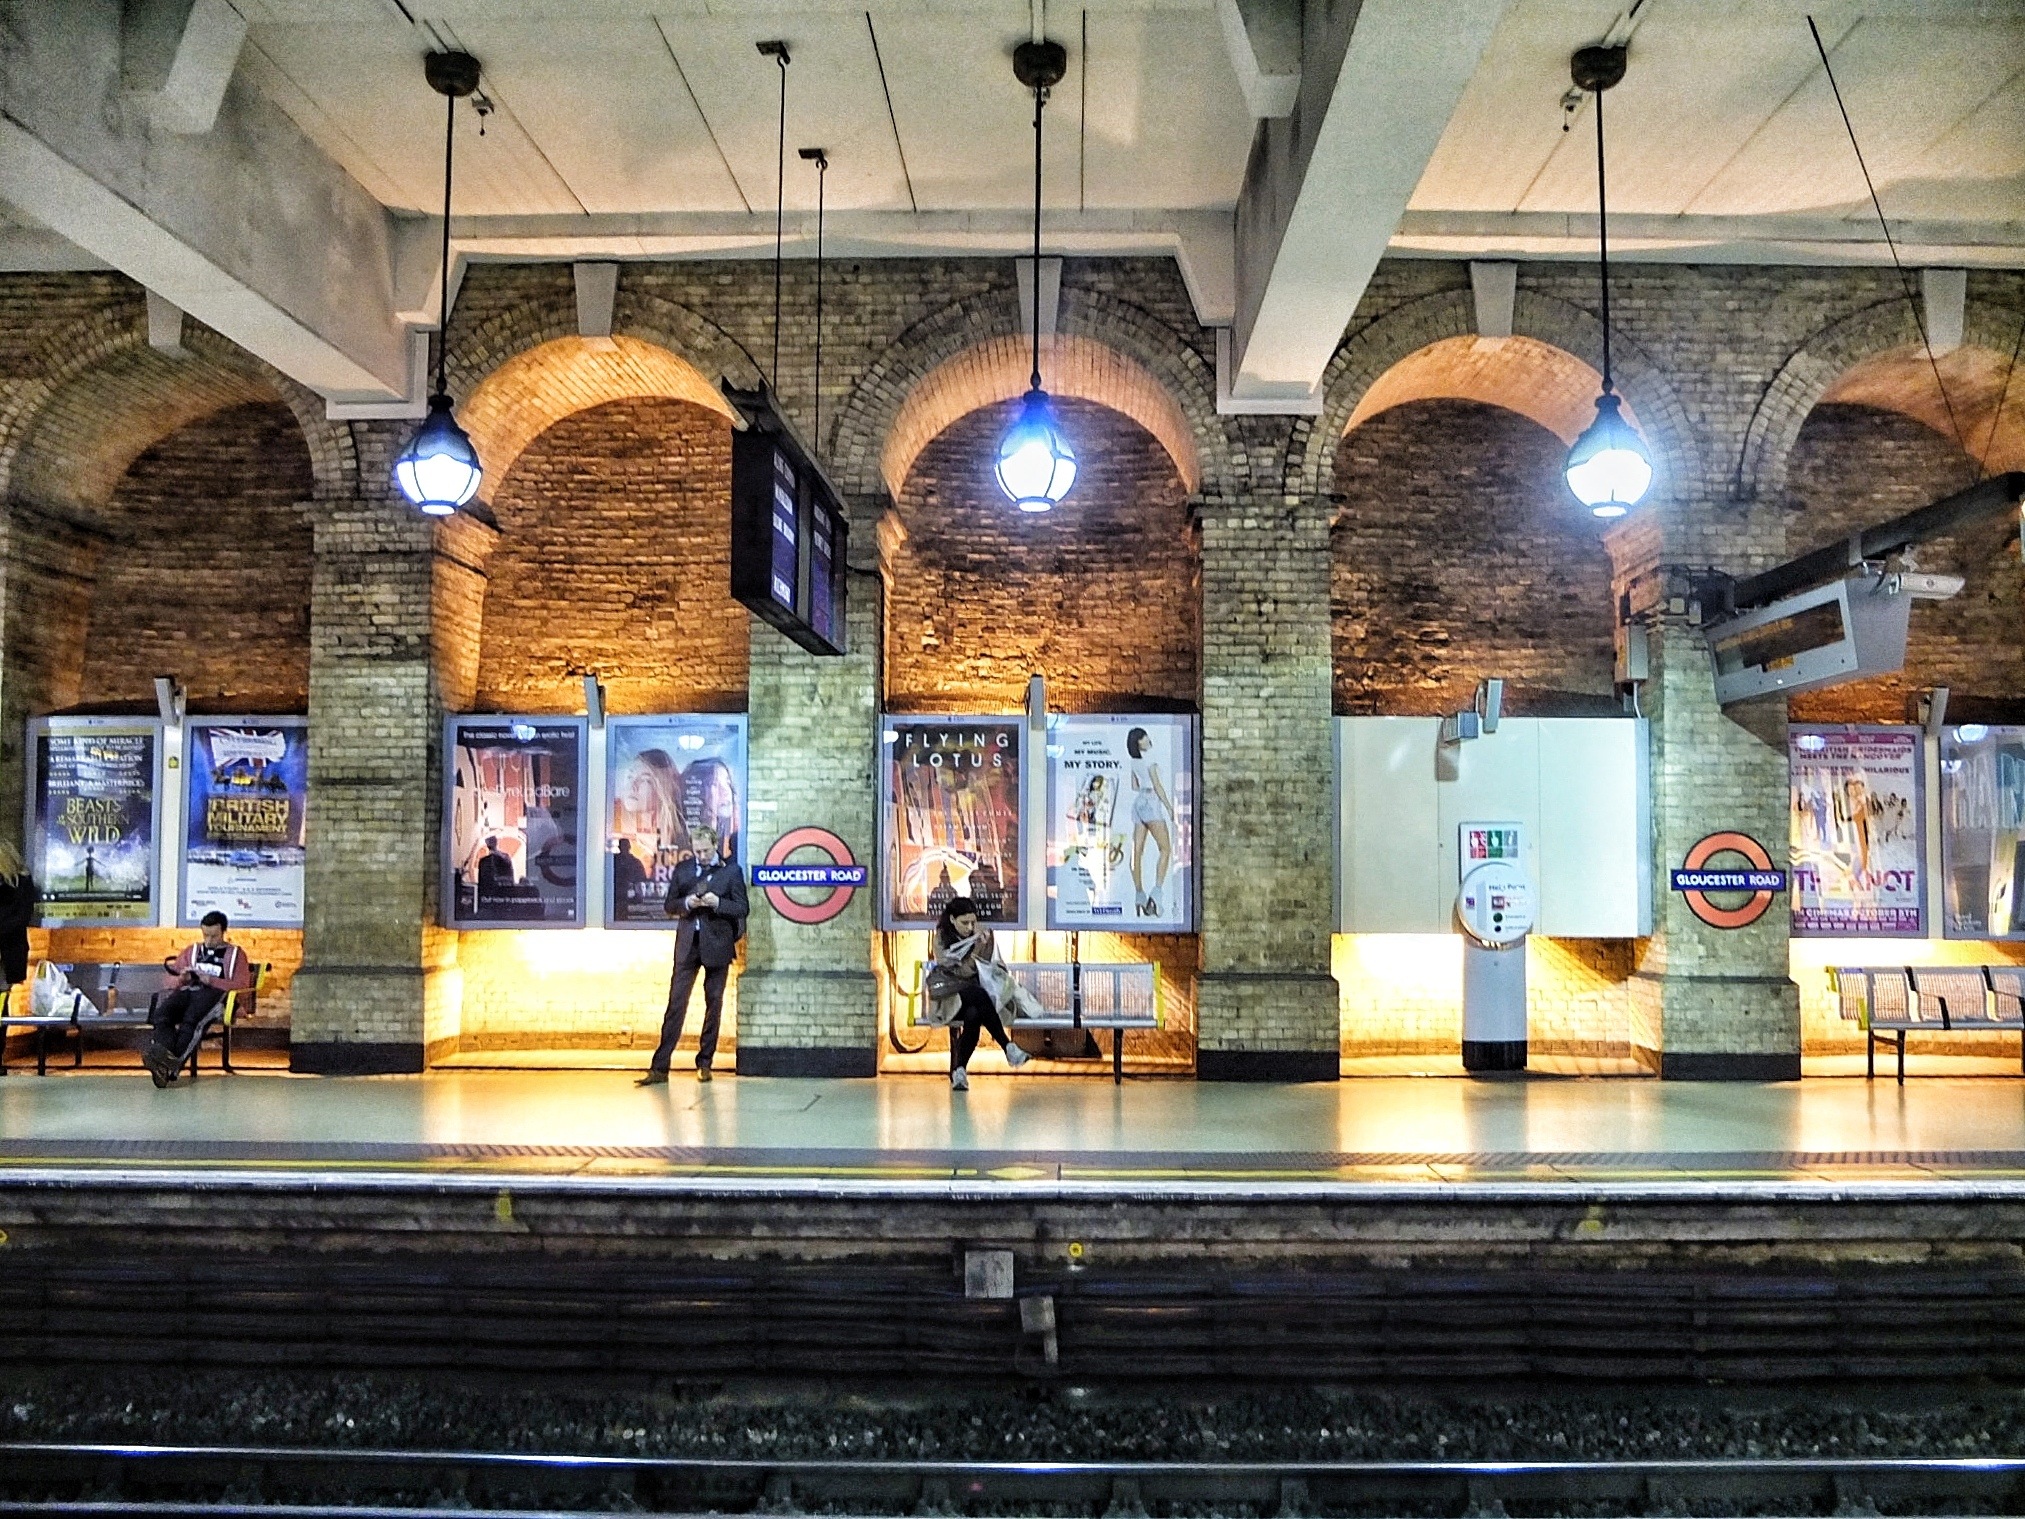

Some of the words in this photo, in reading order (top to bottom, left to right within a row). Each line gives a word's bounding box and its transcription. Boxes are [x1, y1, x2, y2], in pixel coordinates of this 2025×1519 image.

[906, 733, 1009, 748] FLYING
[913, 753, 1002, 768] LOTUS
[1064, 761, 1081, 769] MY
[1084, 760, 1123, 769] STORY.
[66, 797, 121, 815] BEASTS
[67, 812, 130, 825] SOUTHERN
[207, 811, 289, 825] MILITARY
[208, 824, 288, 833] TOURNAMENT
[67, 826, 121, 845] WILD
[758, 870, 827, 882] GLOUCESTER
[830, 870, 862, 882] ROAD
[1676, 874, 1746, 886] GLOUCESTER
[1749, 874, 1781, 886] ROAD
[1806, 908, 1851, 918] CINEMAS
